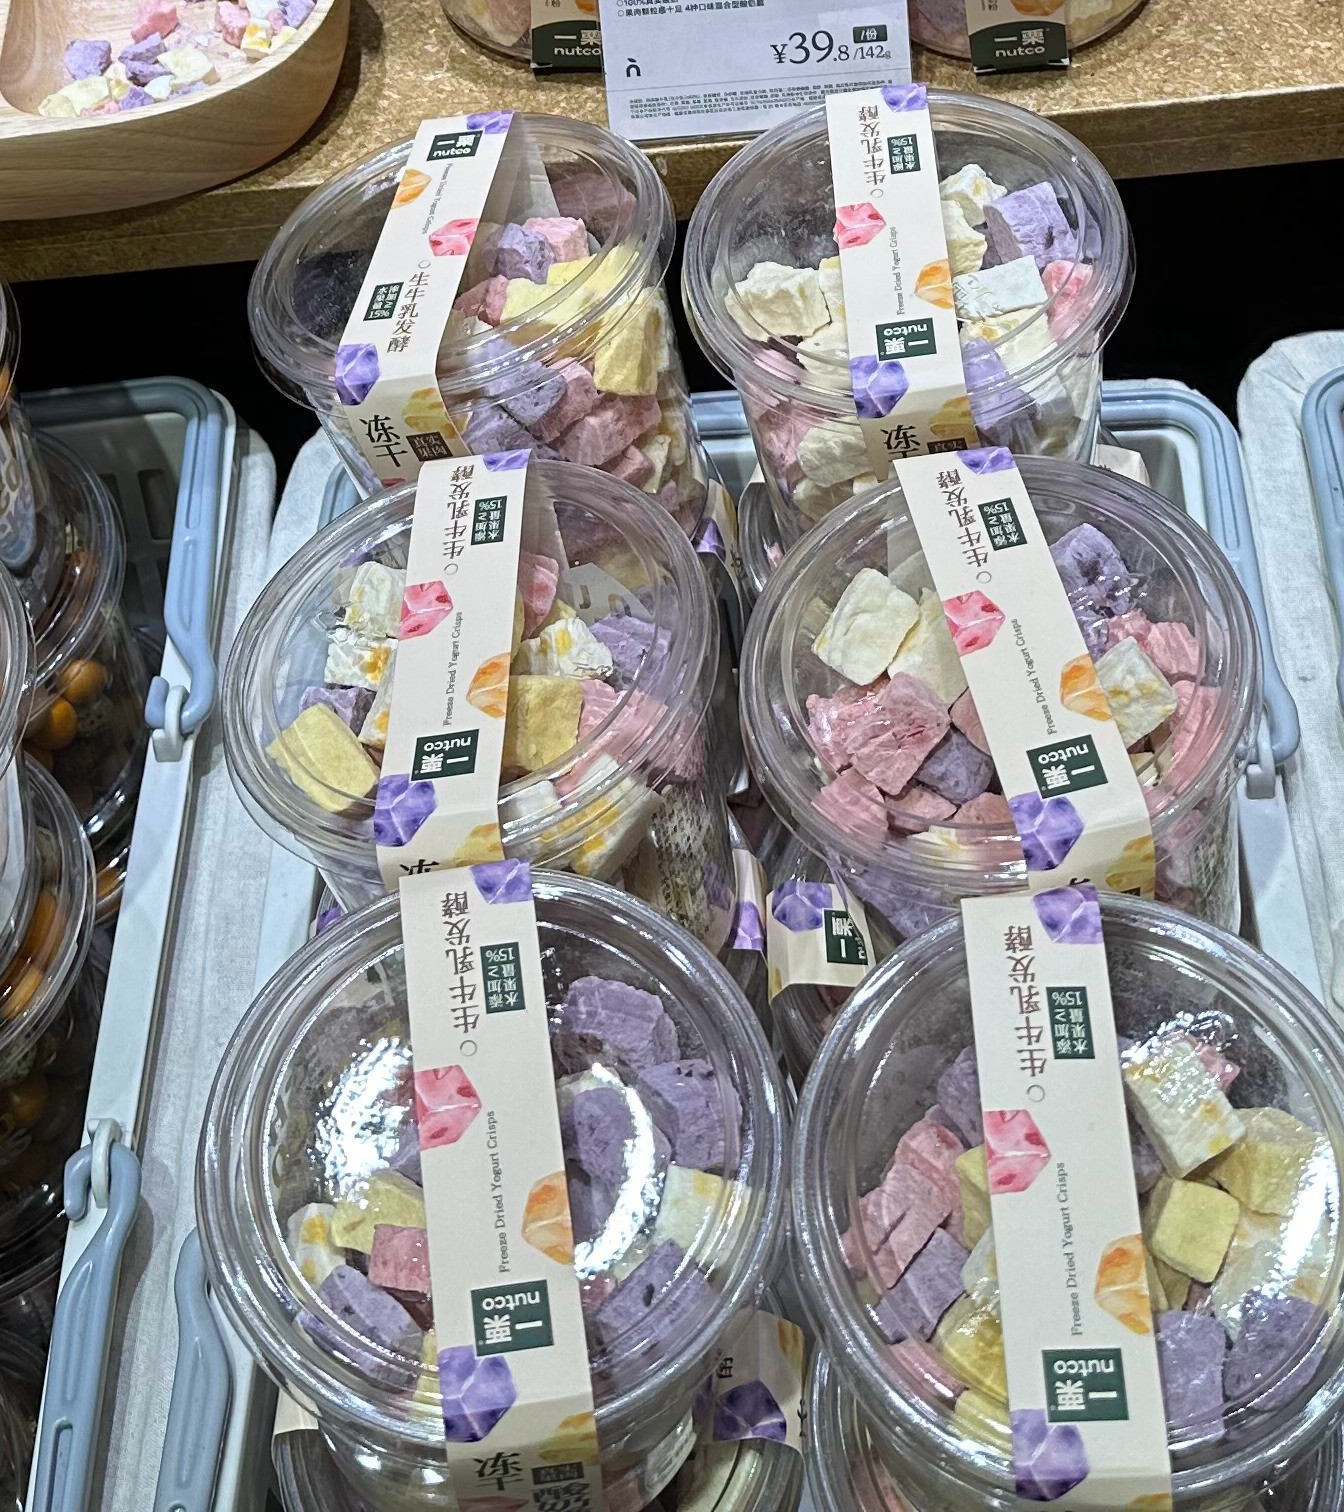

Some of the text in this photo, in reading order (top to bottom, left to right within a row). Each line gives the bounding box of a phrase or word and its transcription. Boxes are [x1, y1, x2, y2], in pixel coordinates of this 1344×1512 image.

[770, 30, 850, 66] ¥39.8
[994, 28, 1045, 46] 一栗
[995, 44, 1046, 58] nutco
[858, 105, 887, 187] 生牛乳发酵
[387, 272, 430, 354] 生牛乳发酵
[883, 323, 929, 337] nutco
[360, 414, 408, 468] 冻干
[443, 464, 475, 560] 生牛乳发酵
[936, 468, 989, 568] 生牛乳发酵
[423, 735, 472, 753] nutco
[1037, 743, 1090, 763] nutco
[419, 752, 470, 775] 一栗
[1041, 763, 1096, 789] 一栗
[441, 891, 480, 1033] 生牛乳发酵
[1003, 925, 1047, 1077] 生牛乳发酵
[486, 1110, 511, 1274] Freeze Dried Yogurt Crisps
[1056, 1162, 1083, 1336] Freeze Dried Yogurt Crisps
[482, 1290, 540, 1310] nutco
[483, 1313, 543, 1345] 一栗
[1053, 1358, 1115, 1377] nutco
[1055, 1379, 1118, 1411] 一栗
[471, 1451, 523, 1491] 冻干
